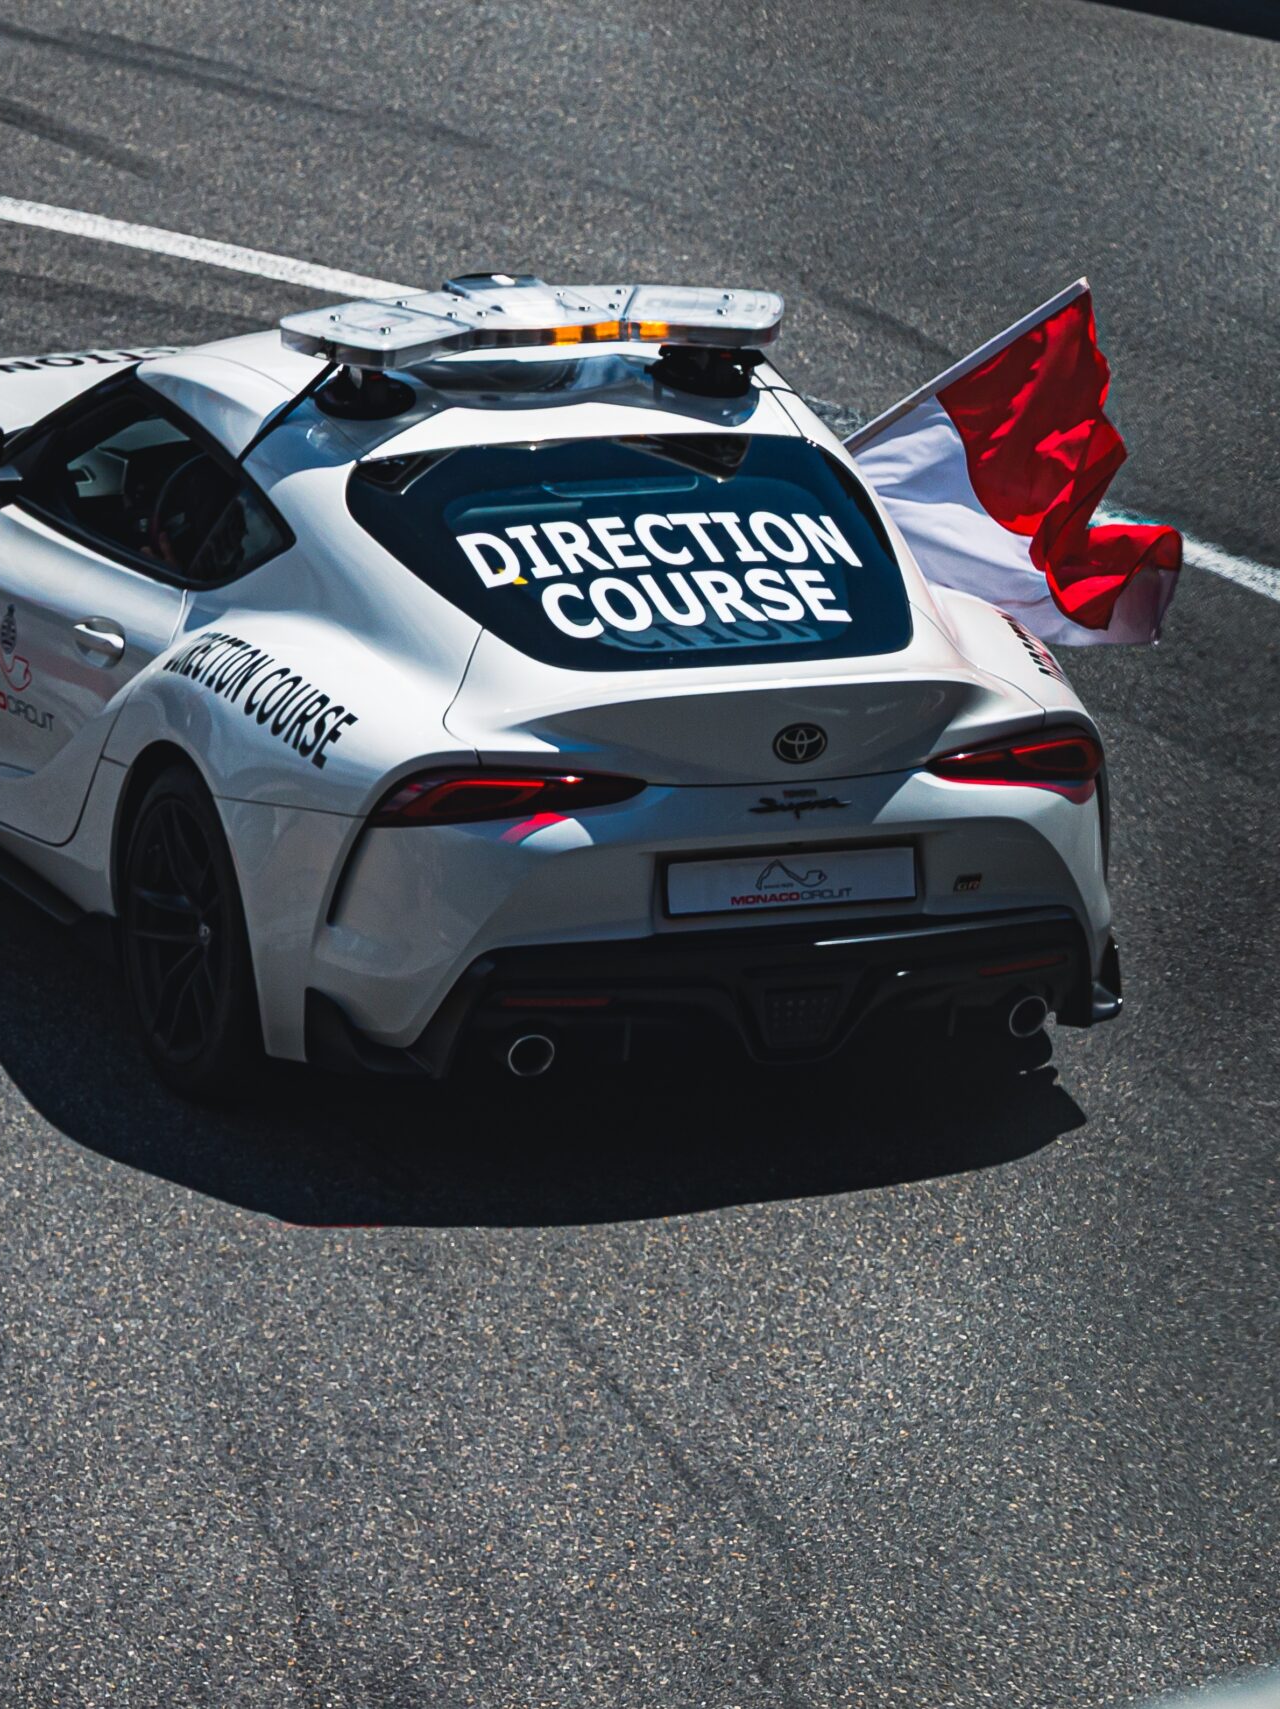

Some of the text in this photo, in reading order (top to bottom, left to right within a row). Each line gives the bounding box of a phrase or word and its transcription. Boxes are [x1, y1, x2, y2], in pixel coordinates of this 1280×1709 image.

[455, 511, 862, 589] DIRECTION
[541, 568, 852, 639] COURSE
[244, 667, 359, 770] COURSE
